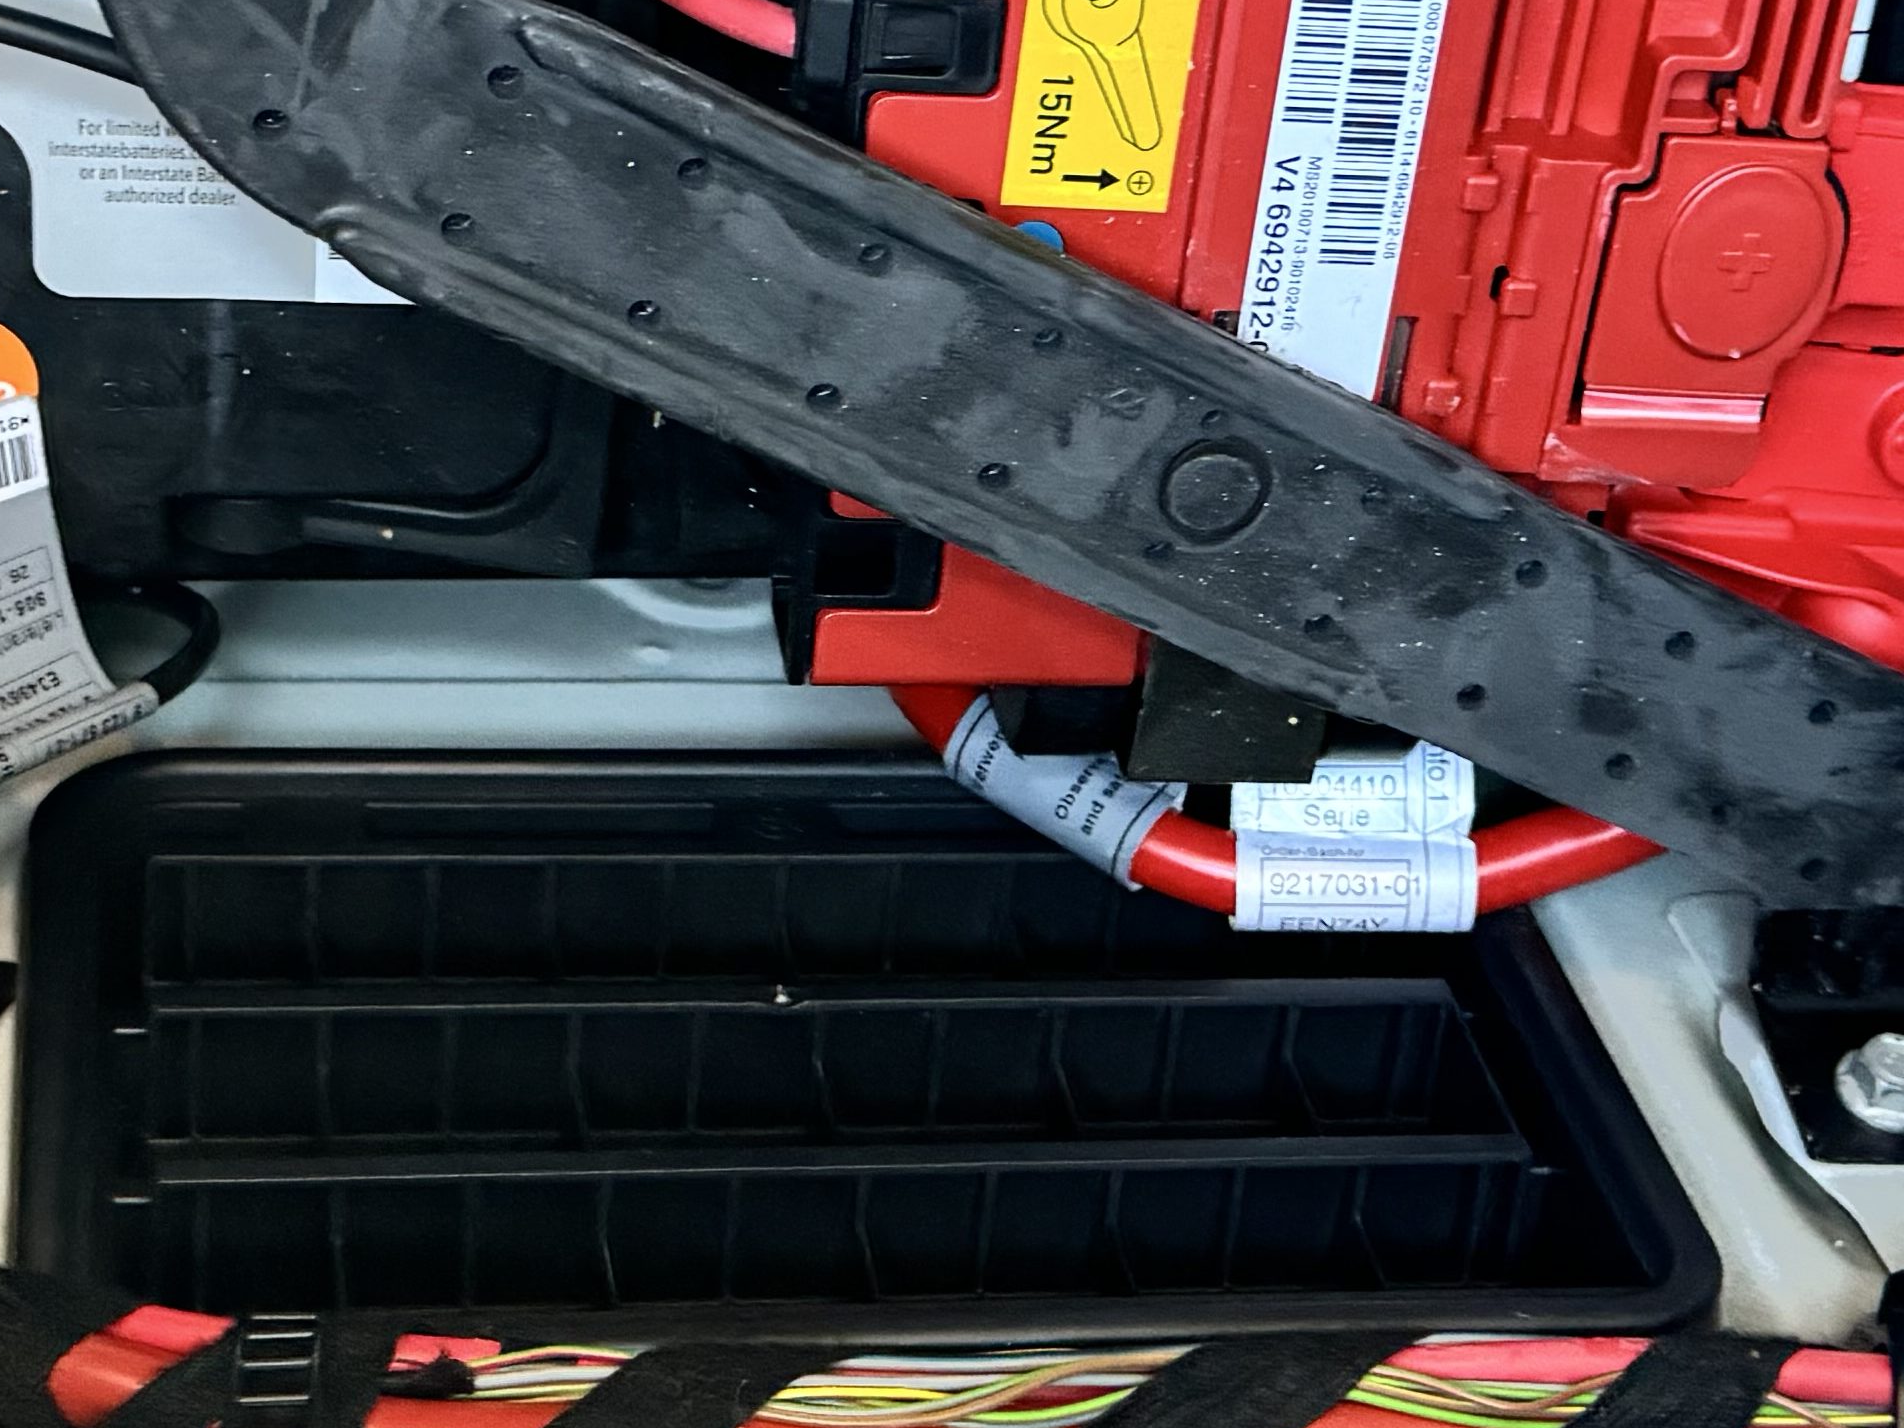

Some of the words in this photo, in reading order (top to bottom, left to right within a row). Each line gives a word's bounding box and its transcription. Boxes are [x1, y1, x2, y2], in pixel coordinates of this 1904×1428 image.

[78, 118, 103, 136] For
[106, 118, 161, 137] limited
[1029, 73, 1075, 176] 15Nm
[78, 166, 96, 181] or
[98, 167, 118, 181] an
[121, 164, 193, 183] Interstate
[1270, 155, 1302, 194] V4
[103, 185, 185, 205] authorized
[1080, 799, 1106, 836] and
[1269, 872, 1422, 897] 9217031-01
